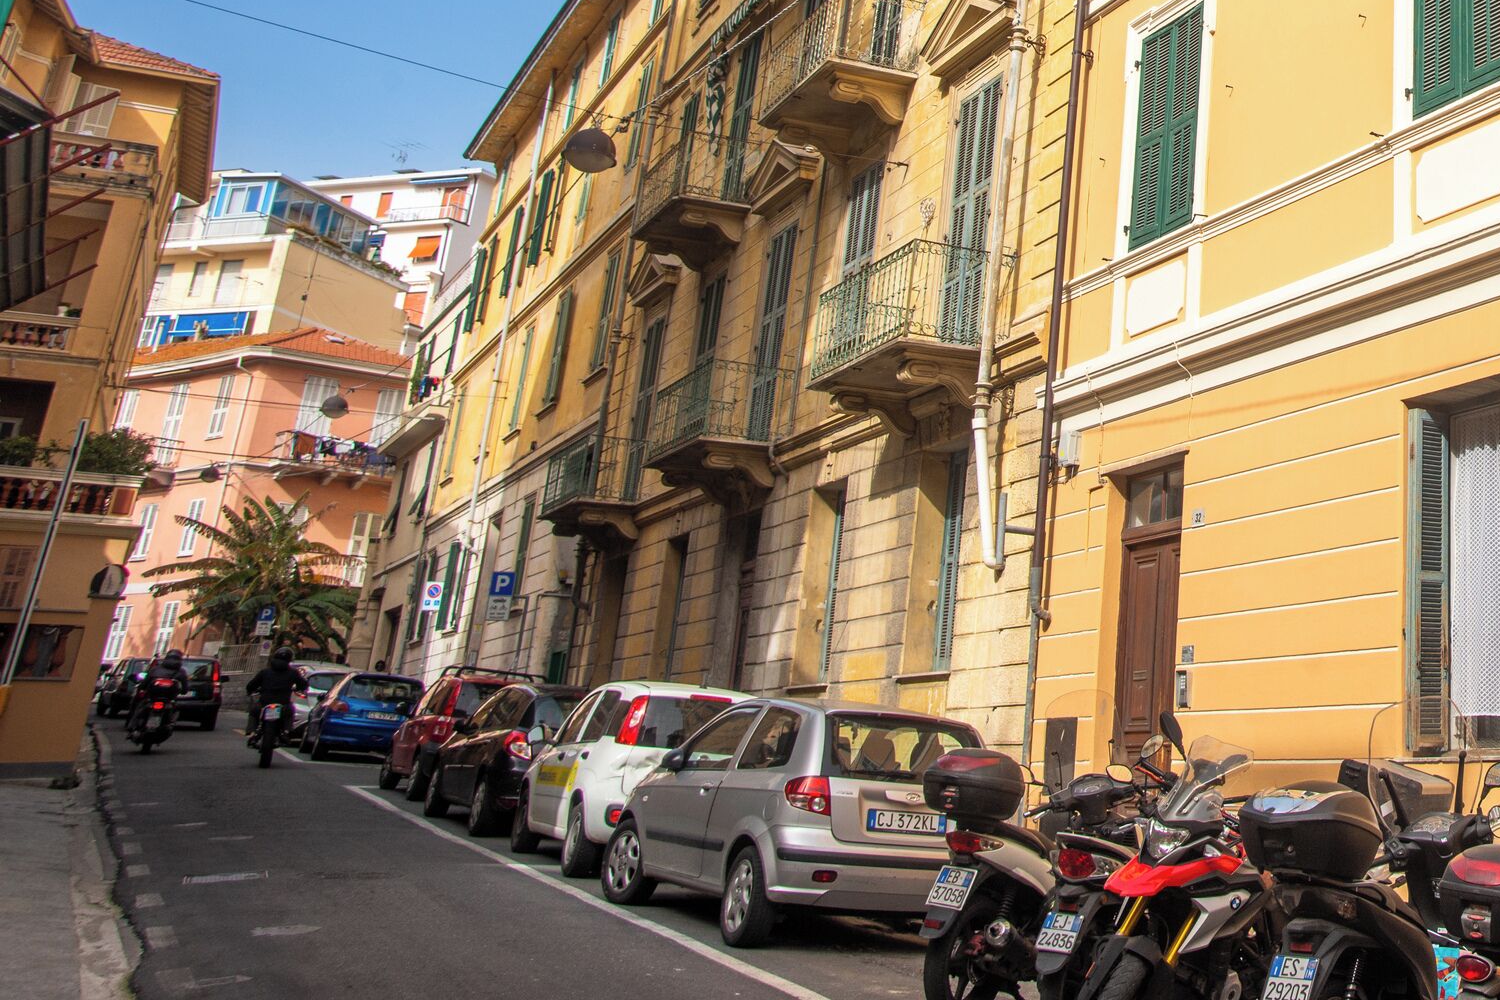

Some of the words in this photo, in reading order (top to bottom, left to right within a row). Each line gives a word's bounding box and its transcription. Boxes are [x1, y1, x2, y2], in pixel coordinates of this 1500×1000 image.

[495, 575, 510, 593] P
[261, 608, 272, 620] P
[877, 812, 893, 828] CJ
[897, 813, 937, 831] 372KL
[946, 869, 961, 884] EB
[932, 885, 965, 904] 37058
[1052, 914, 1069, 929] EJ
[1037, 931, 1075, 950] 24836
[1281, 958, 1300, 976] ES
[1265, 982, 1309, 1000] 29203
